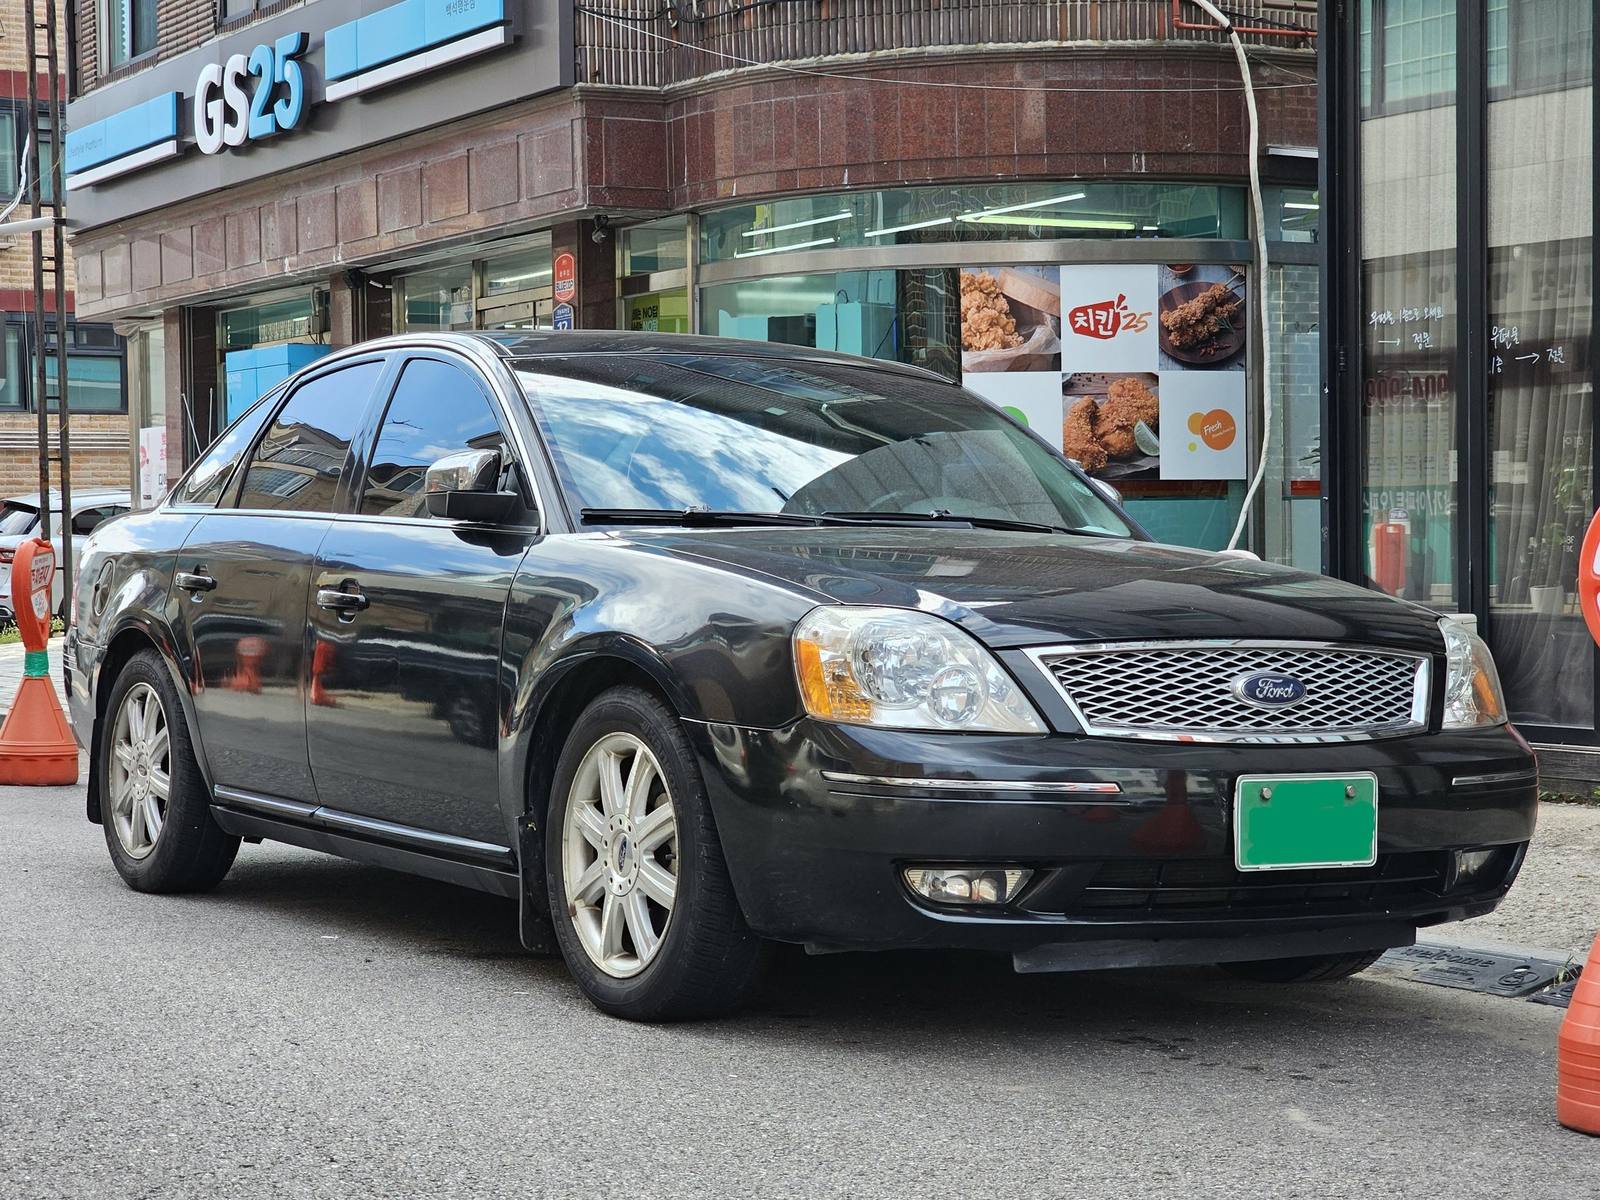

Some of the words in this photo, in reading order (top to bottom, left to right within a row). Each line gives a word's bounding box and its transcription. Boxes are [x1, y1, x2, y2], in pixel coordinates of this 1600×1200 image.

[194, 31, 306, 154] GS25
[1412, 332, 1433, 350] 정문
[1546, 346, 1565, 364] 정문
[1203, 420, 1222, 436] Fresh
[1255, 678, 1294, 698] Ford
[1401, 948, 1496, 968] welcome
